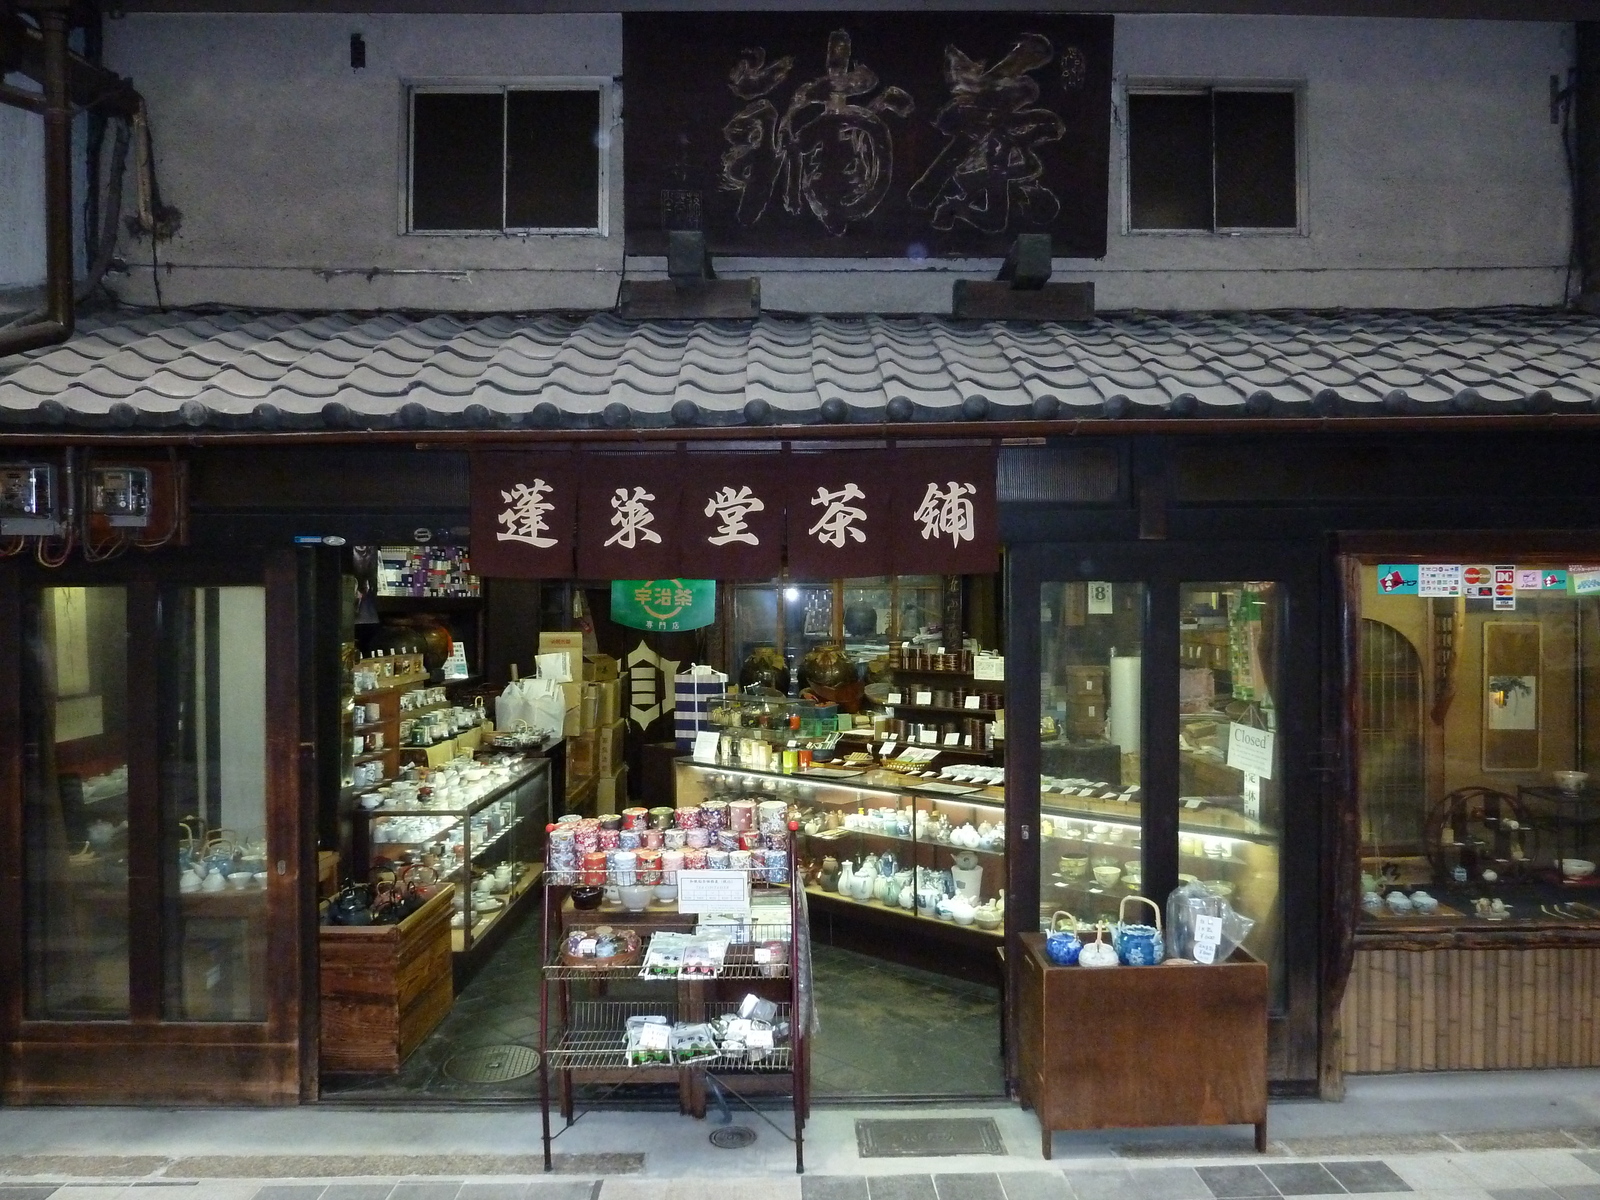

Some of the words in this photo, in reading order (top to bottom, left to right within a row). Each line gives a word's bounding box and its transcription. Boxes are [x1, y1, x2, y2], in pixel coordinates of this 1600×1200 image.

[634, 587, 693, 606] 宇治茶
[1095, 586, 1106, 600] 8
[1234, 728, 1266, 749] Closed
